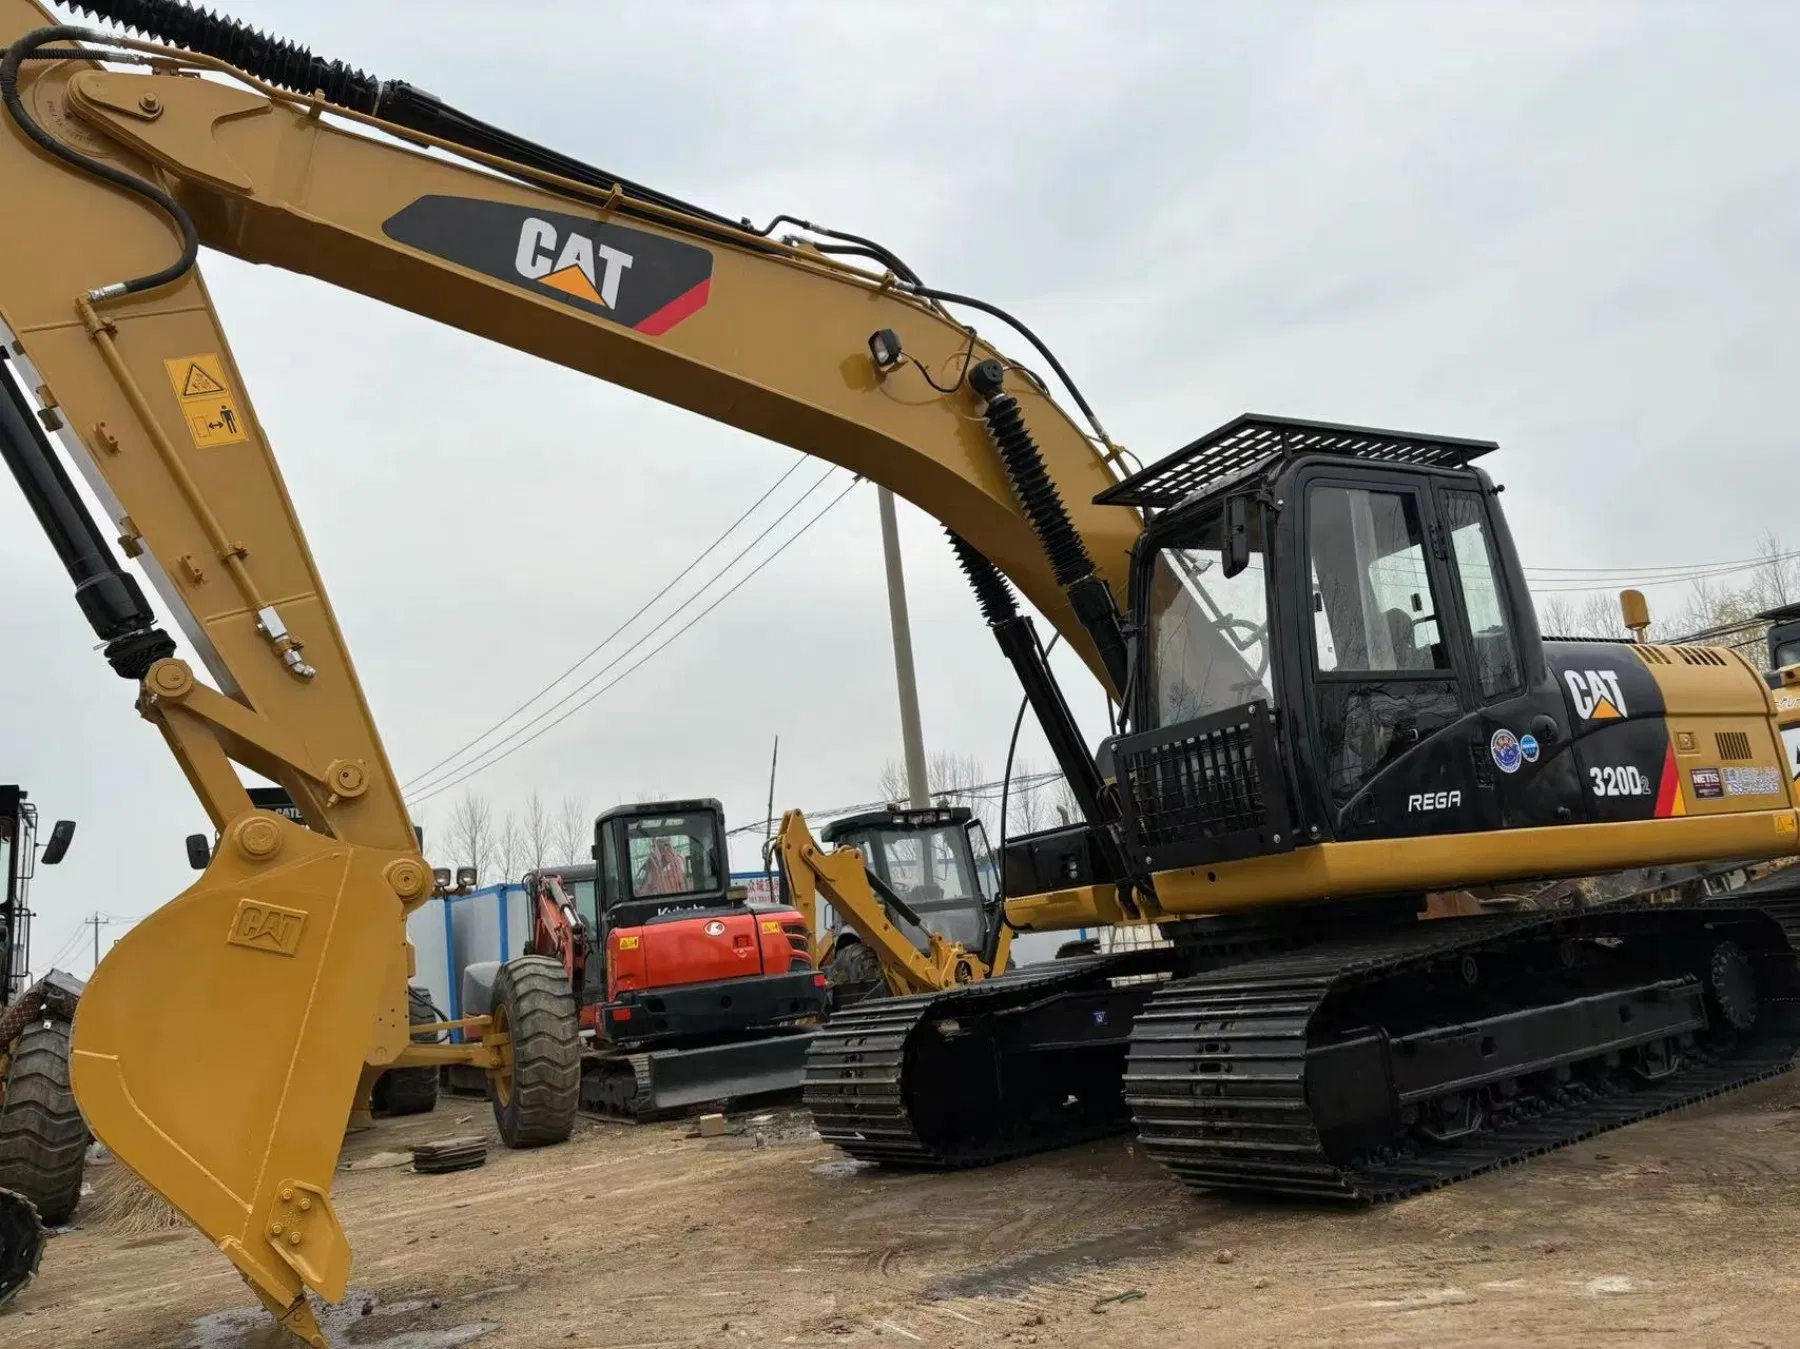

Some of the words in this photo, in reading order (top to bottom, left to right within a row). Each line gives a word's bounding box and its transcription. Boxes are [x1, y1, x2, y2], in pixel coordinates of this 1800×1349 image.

[515, 216, 634, 311] CAT
[1563, 669, 1628, 720] CAT
[1692, 773, 1721, 784] NETIS
[1407, 790, 1462, 813] REGA
[235, 906, 302, 949] CAT
